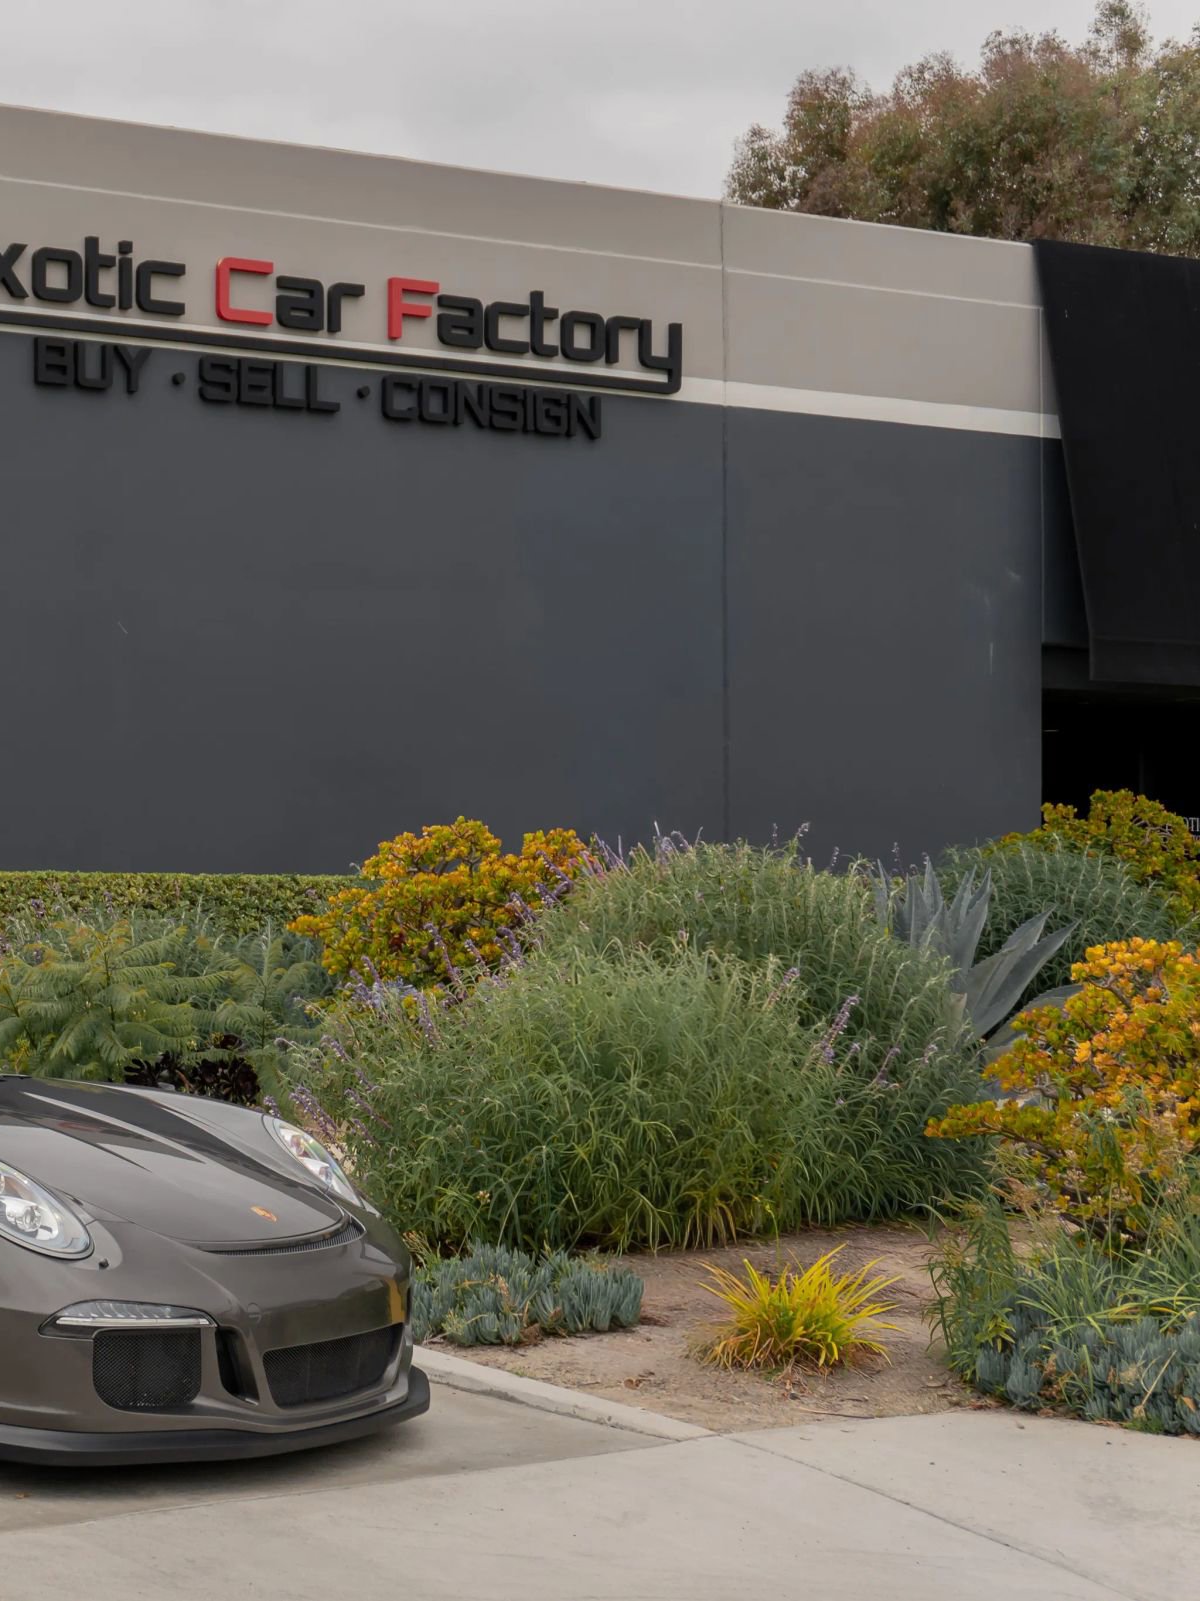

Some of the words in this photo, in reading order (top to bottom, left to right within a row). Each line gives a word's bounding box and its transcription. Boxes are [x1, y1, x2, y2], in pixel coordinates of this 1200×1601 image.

[215, 256, 365, 333] Car
[387, 276, 683, 394] Factory
[34, 336, 153, 395] BUY
[198, 355, 341, 414] SELL
[381, 372, 602, 440] CONSIGN
